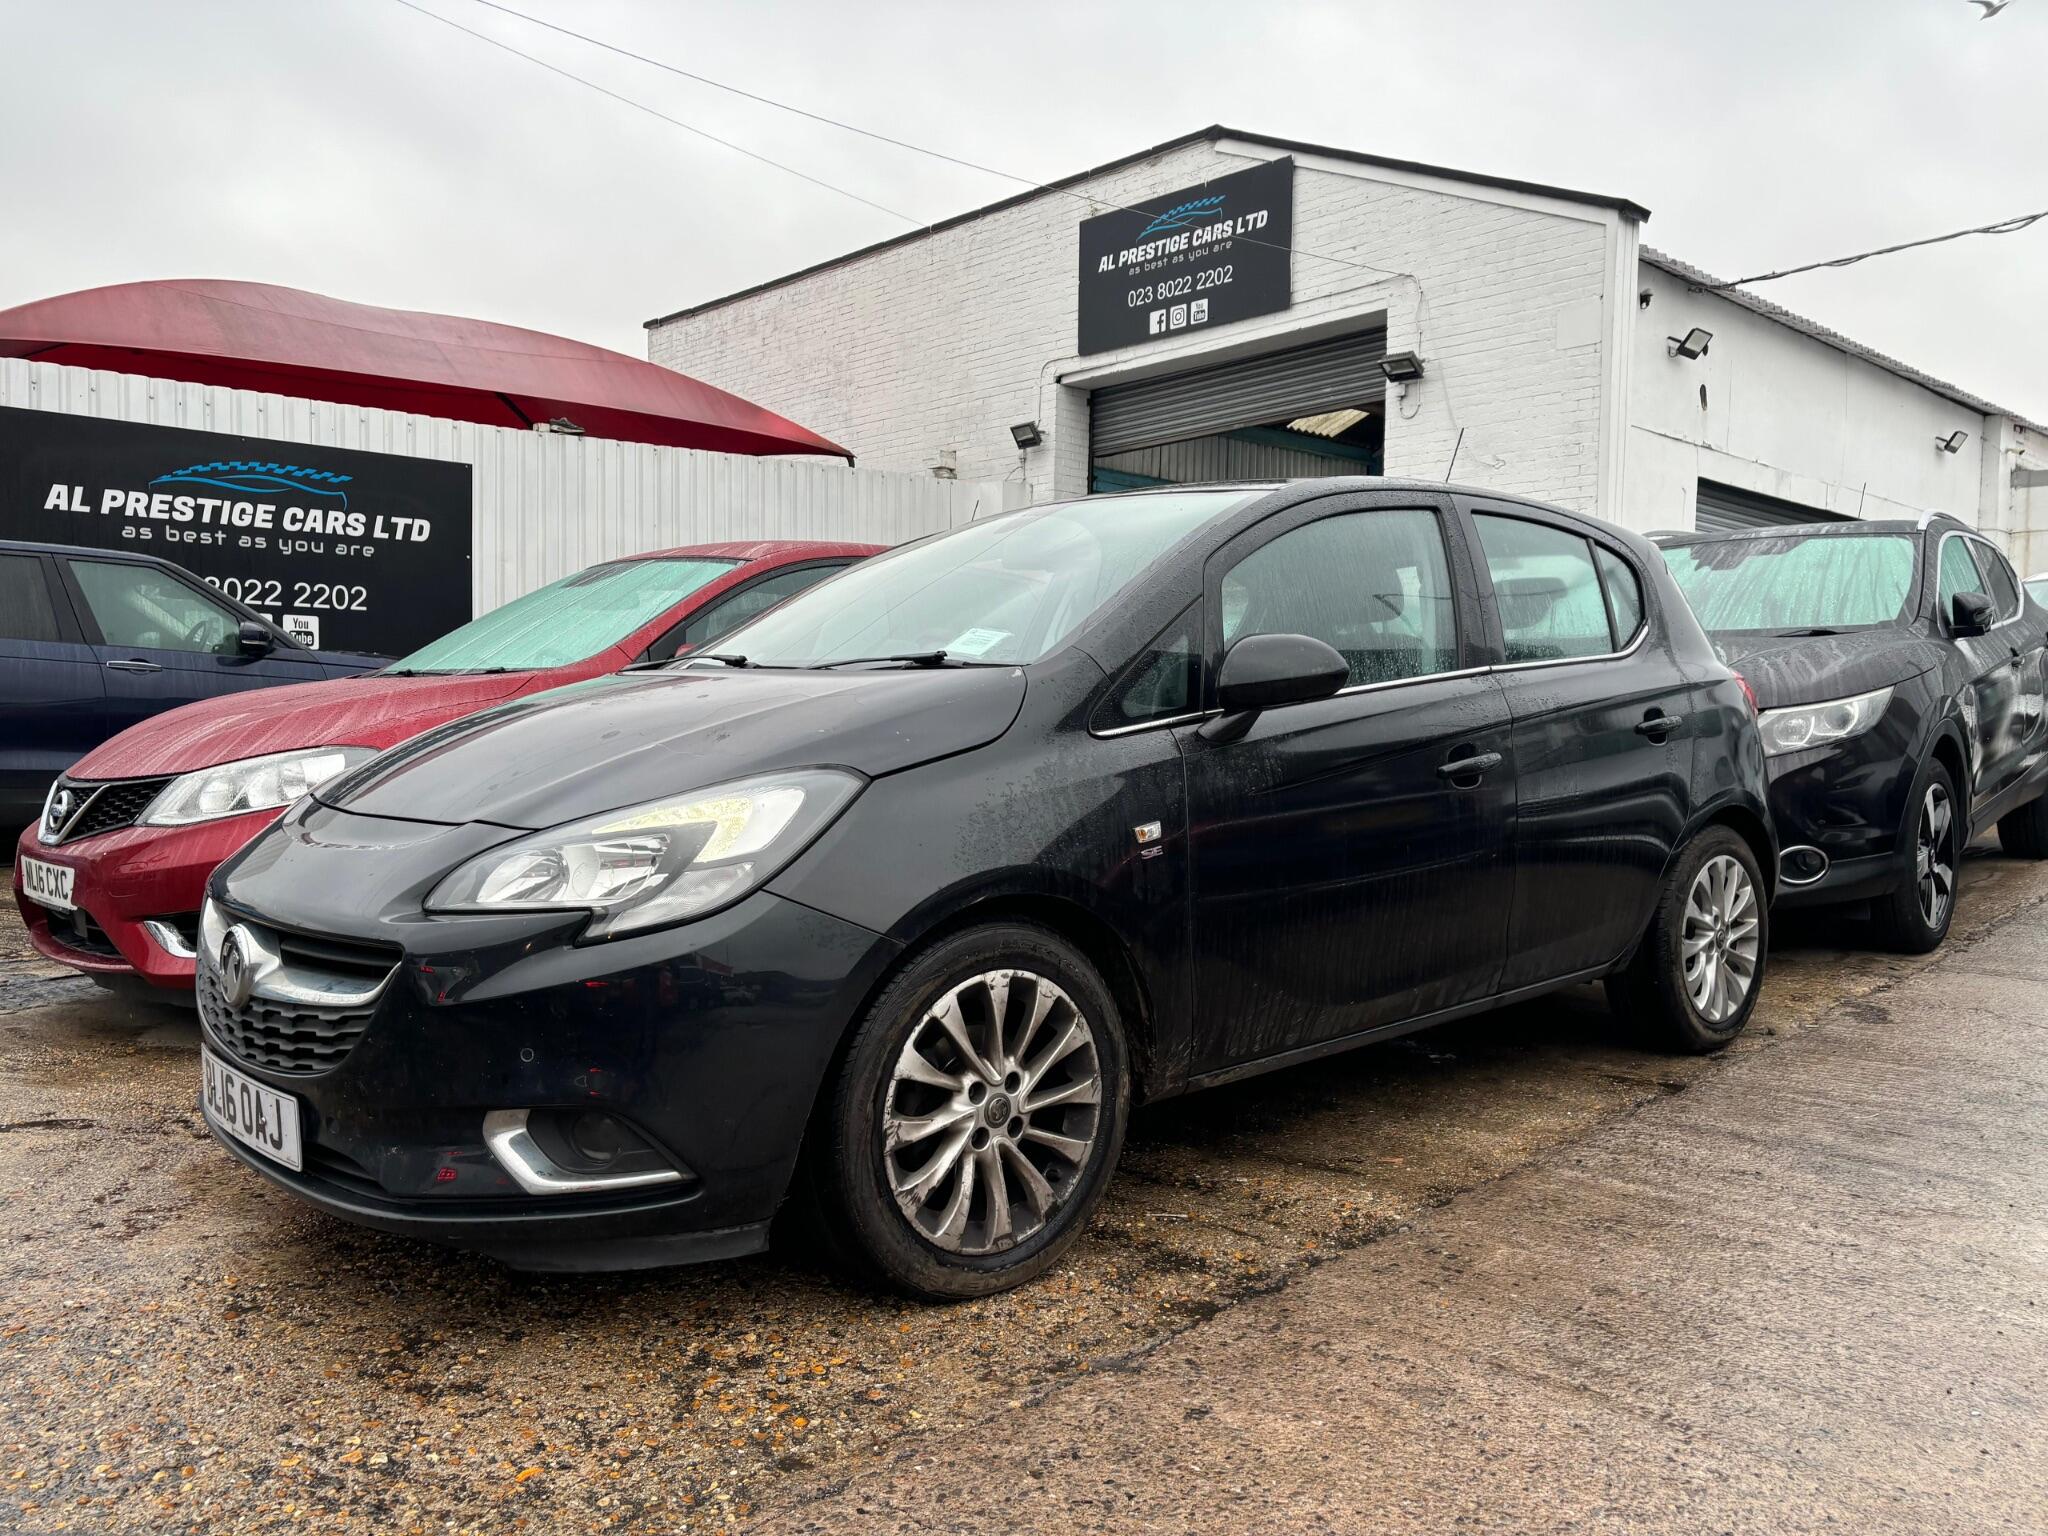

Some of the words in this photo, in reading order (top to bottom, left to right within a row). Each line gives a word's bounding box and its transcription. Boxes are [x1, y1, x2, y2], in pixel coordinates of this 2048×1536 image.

[1098, 254, 1115, 273] AL
[1118, 231, 1190, 267] PRESTIGE
[1192, 219, 1233, 247] CARS
[1236, 210, 1268, 236] LTD
[1129, 265, 1141, 276] as
[1144, 257, 1168, 272] best
[1172, 253, 1184, 264] as
[1188, 248, 1209, 262] you
[1213, 241, 1233, 253] are
[1128, 286, 1153, 307] 023
[1157, 275, 1192, 300] 8022
[1196, 265, 1233, 290] 2202
[44, 484, 91, 513] AL
[100, 488, 276, 528] PRESTIGE
[282, 507, 366, 537] CARS
[373, 515, 431, 543] LTD
[122, 526, 152, 540] as
[166, 524, 227, 546] best
[239, 534, 267, 549] as
[278, 537, 324, 555] you
[335, 543, 375, 558] are
[293, 582, 367, 611] 2202
[292, 617, 309, 630] You
[25, 860, 45, 894] NL16
[45, 867, 69, 900] CXC
[240, 1082, 283, 1151] OAJ
